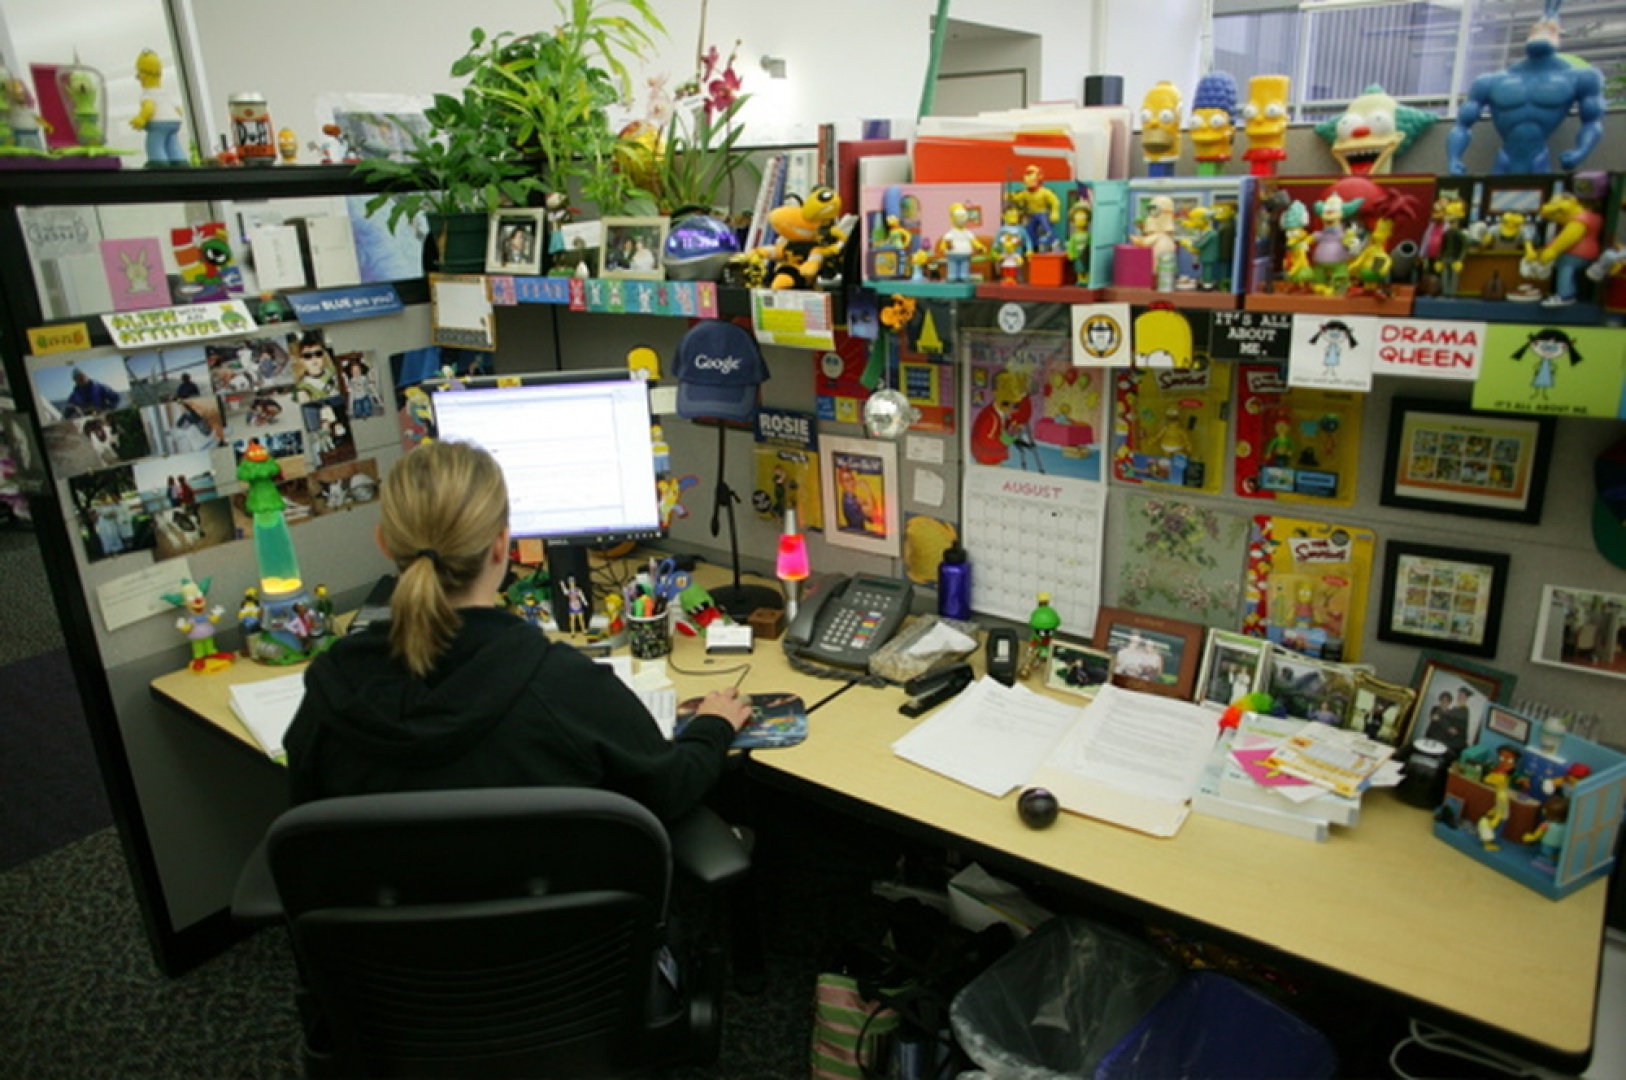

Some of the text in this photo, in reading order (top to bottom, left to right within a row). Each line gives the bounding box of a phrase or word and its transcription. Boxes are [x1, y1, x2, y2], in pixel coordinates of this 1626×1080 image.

[1214, 311, 1291, 328] IT'S ALL
[1227, 327, 1277, 341] ABOUT
[1381, 324, 1478, 347] DRAMA
[1239, 343, 1268, 356] ME.
[1379, 345, 1474, 369] QUEEN
[694, 353, 742, 375] Google
[1536, 403, 1570, 412] ABOUT
[758, 412, 810, 436] ROSIE
[1002, 480, 1063, 498] AUGUST
